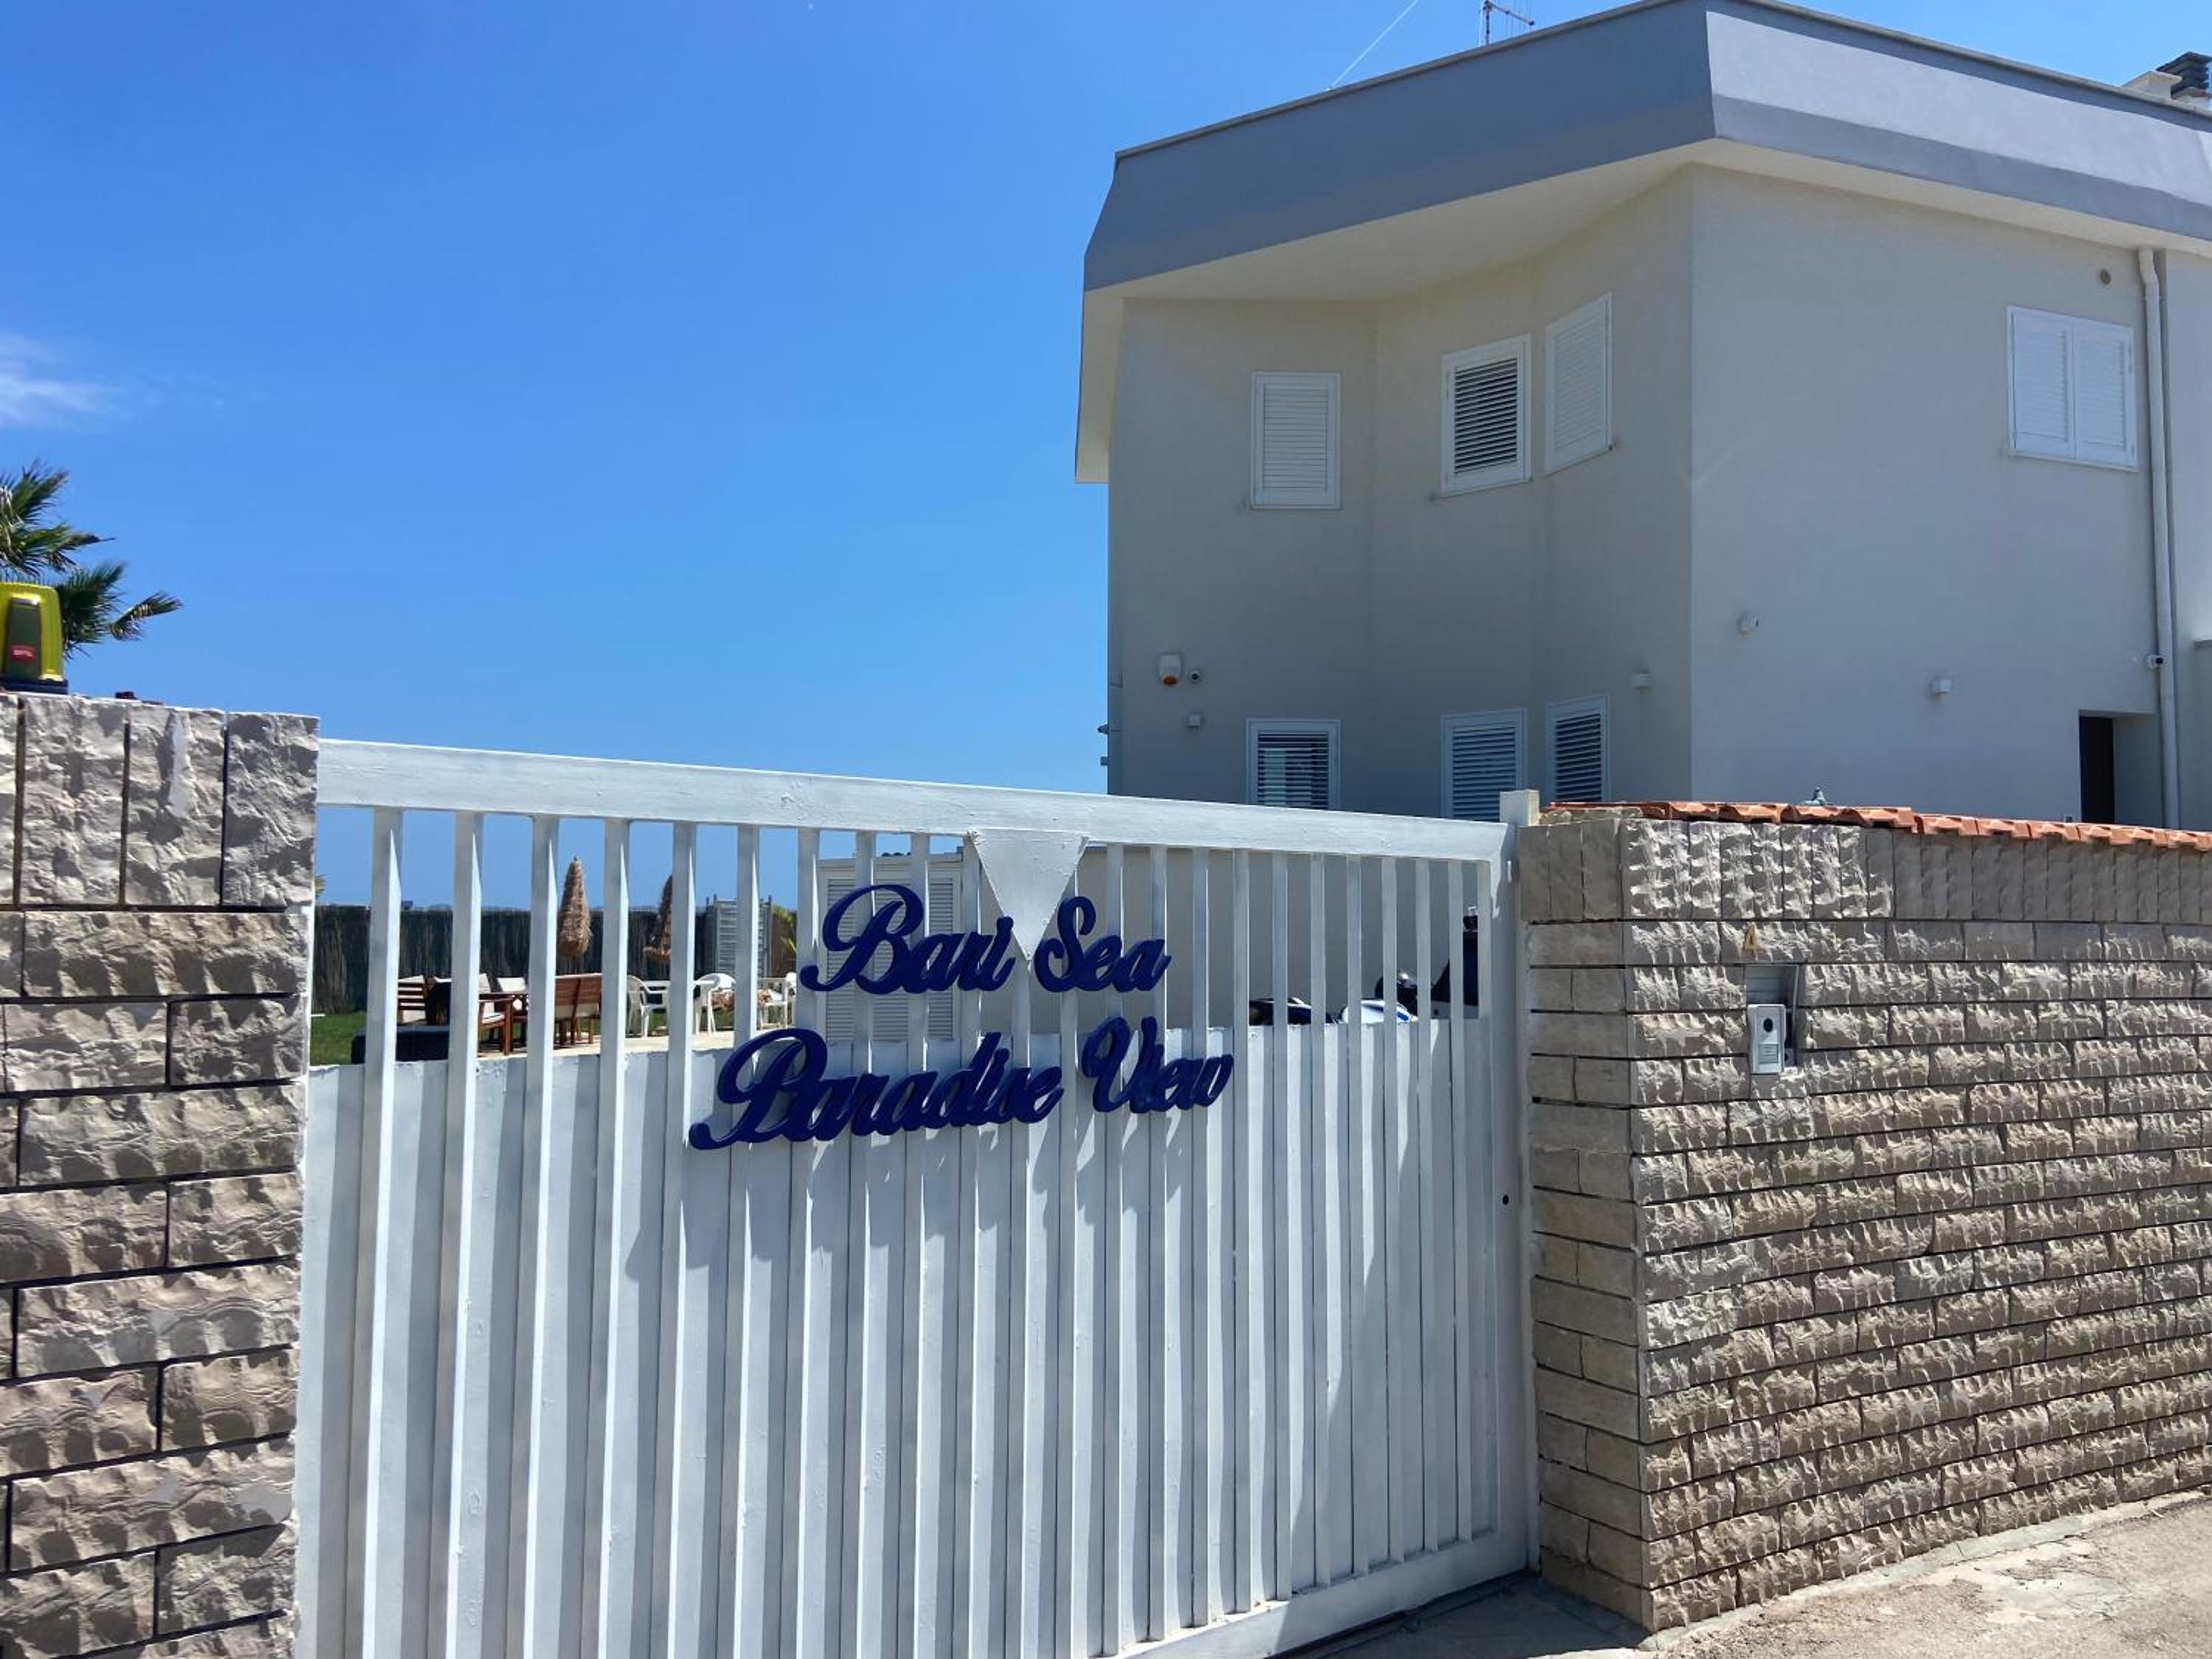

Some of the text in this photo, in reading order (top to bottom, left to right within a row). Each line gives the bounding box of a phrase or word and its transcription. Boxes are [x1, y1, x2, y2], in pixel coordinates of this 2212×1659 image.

[800, 884, 1171, 995] Bari Sea
[689, 1015, 1234, 1150] Paradise View
